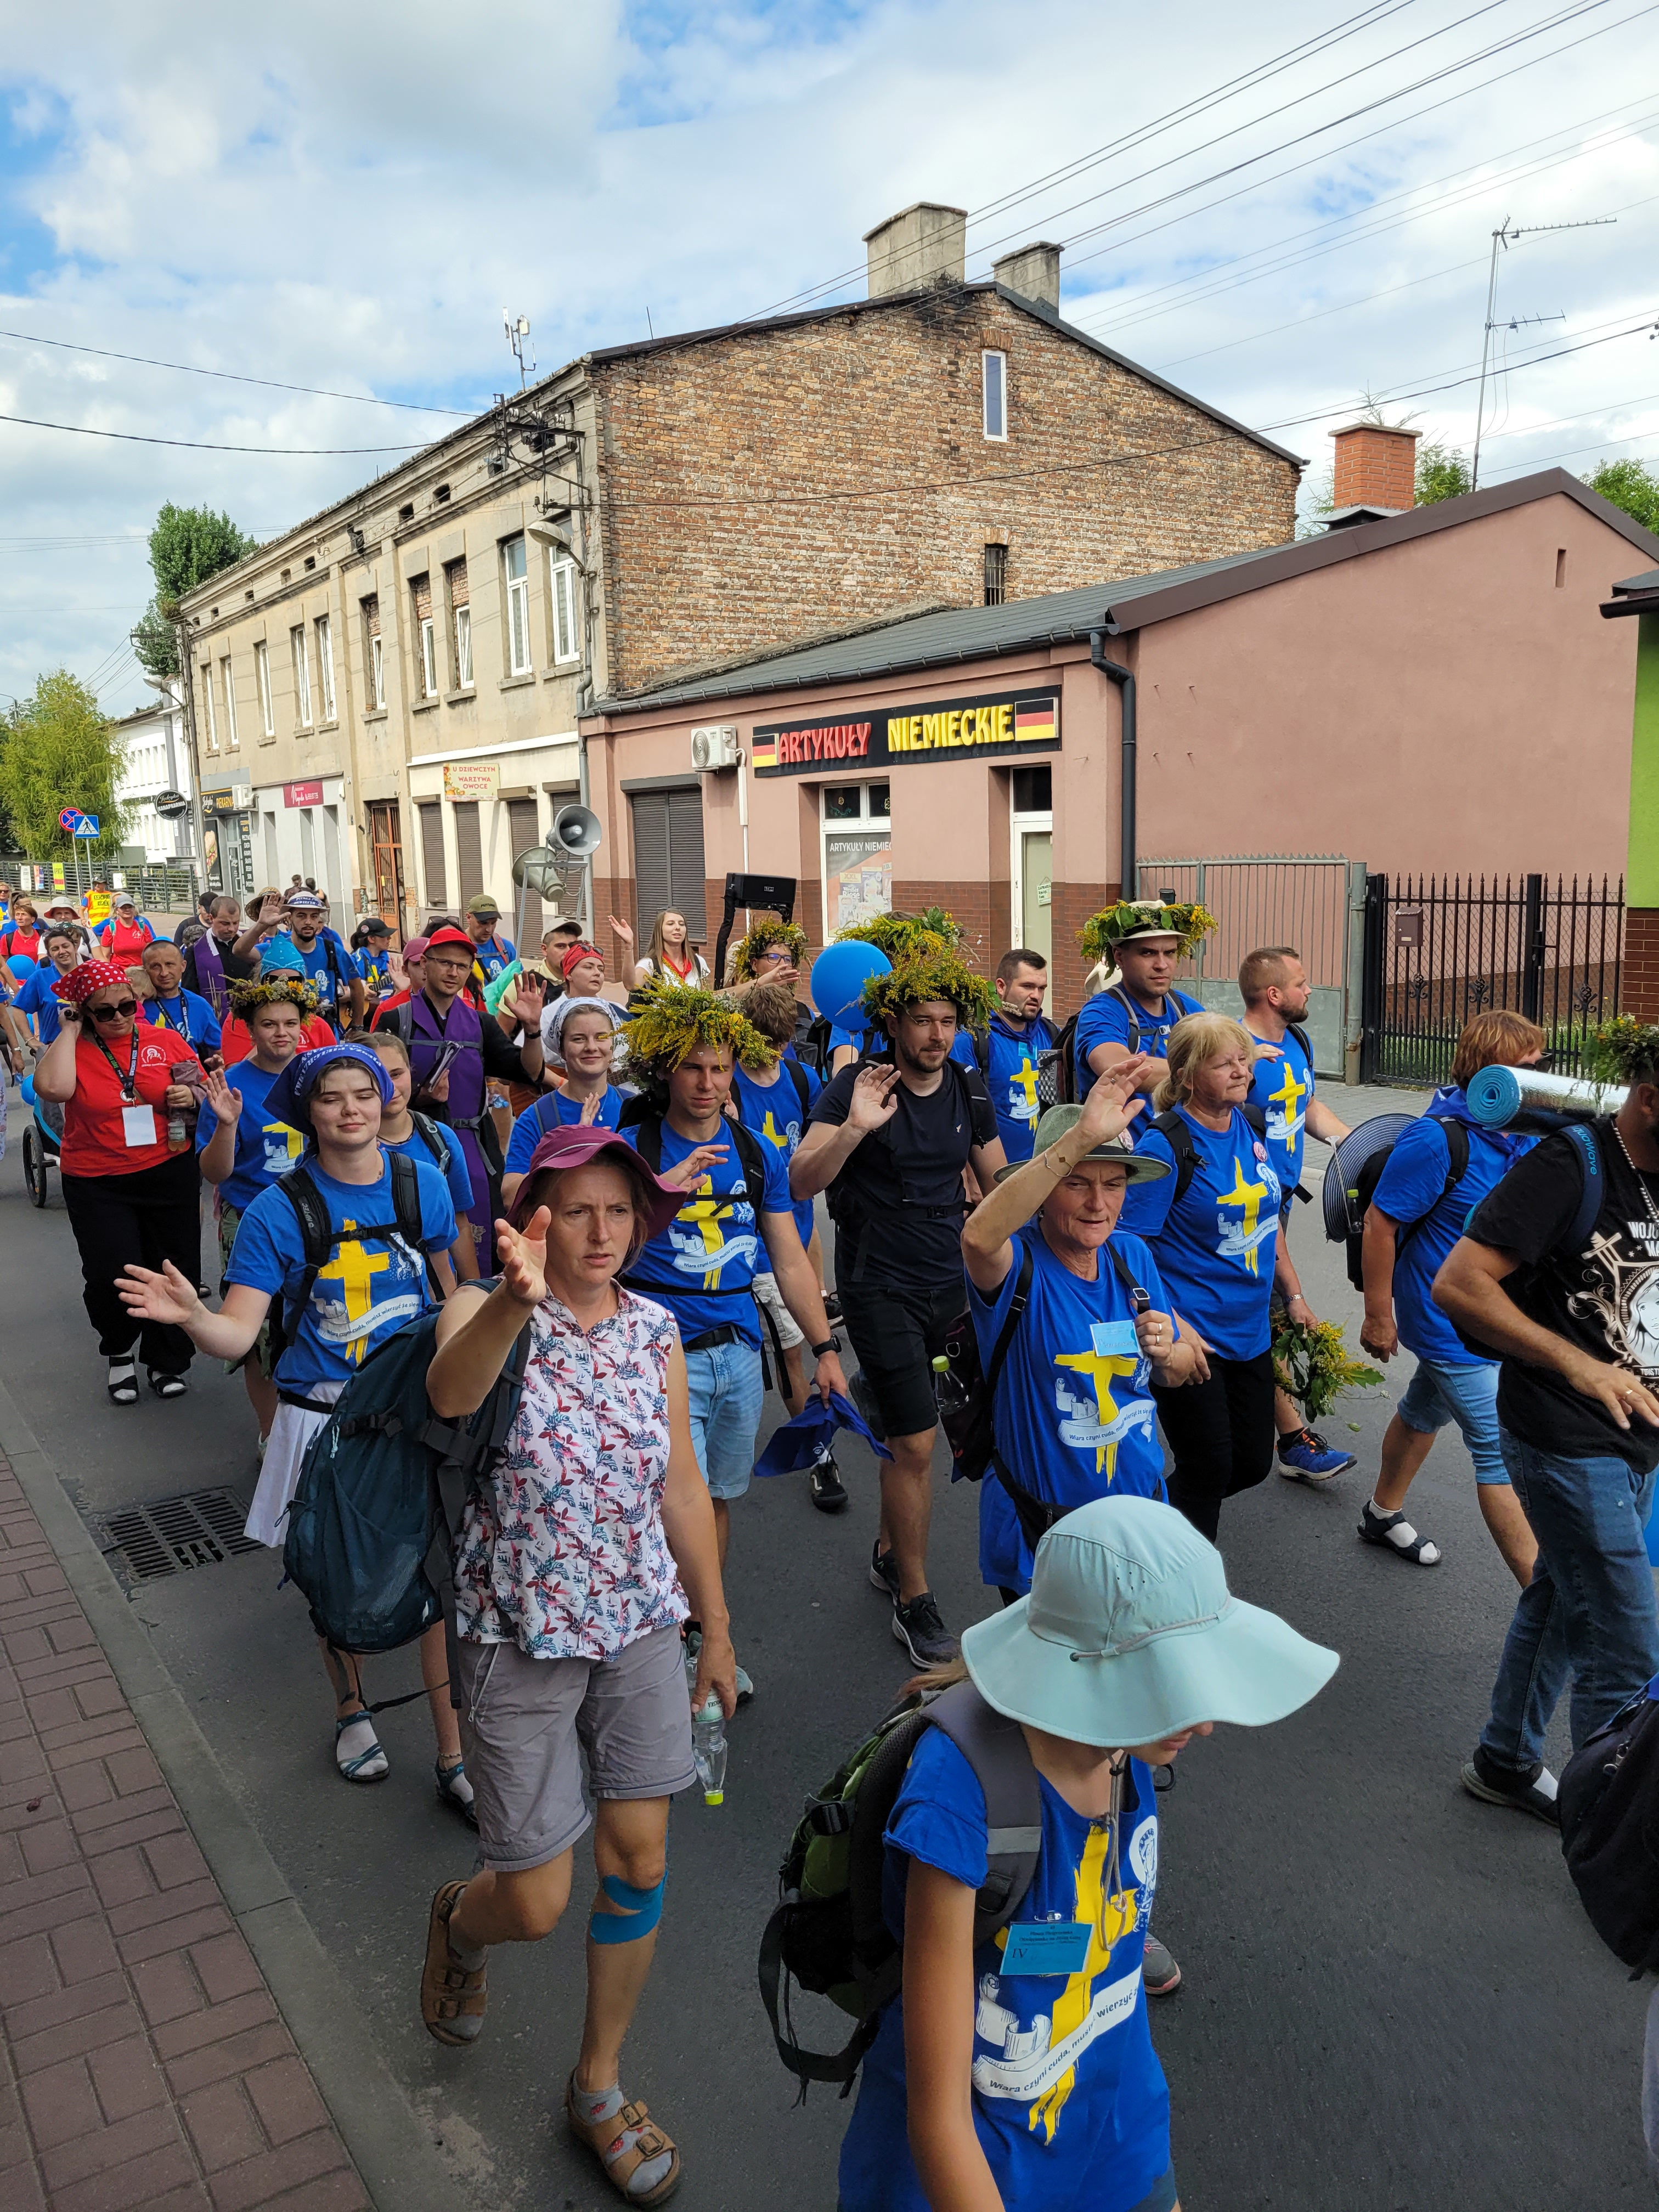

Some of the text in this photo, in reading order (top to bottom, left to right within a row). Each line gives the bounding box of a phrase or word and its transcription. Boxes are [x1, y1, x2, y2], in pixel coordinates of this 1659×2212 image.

[778, 723, 871, 764] ARTYKUŁY
[887, 704, 1014, 752] NIEMIECKIE
[830, 842, 864, 852] ARTYKUŁY
[1571, 1126, 1597, 1175] quaWave
[1069, 1433, 1085, 1441] Wiara
[1086, 1432, 1101, 1441] czyni
[1101, 1430, 1116, 1438] cuda,
[1012, 1948, 1028, 1959] IV
[989, 2079, 1020, 2092] Wiara
[1024, 2067, 1047, 2091] czyni
[1048, 2048, 1071, 2072] cuda,
[1097, 1989, 1133, 2019] wierzyć
